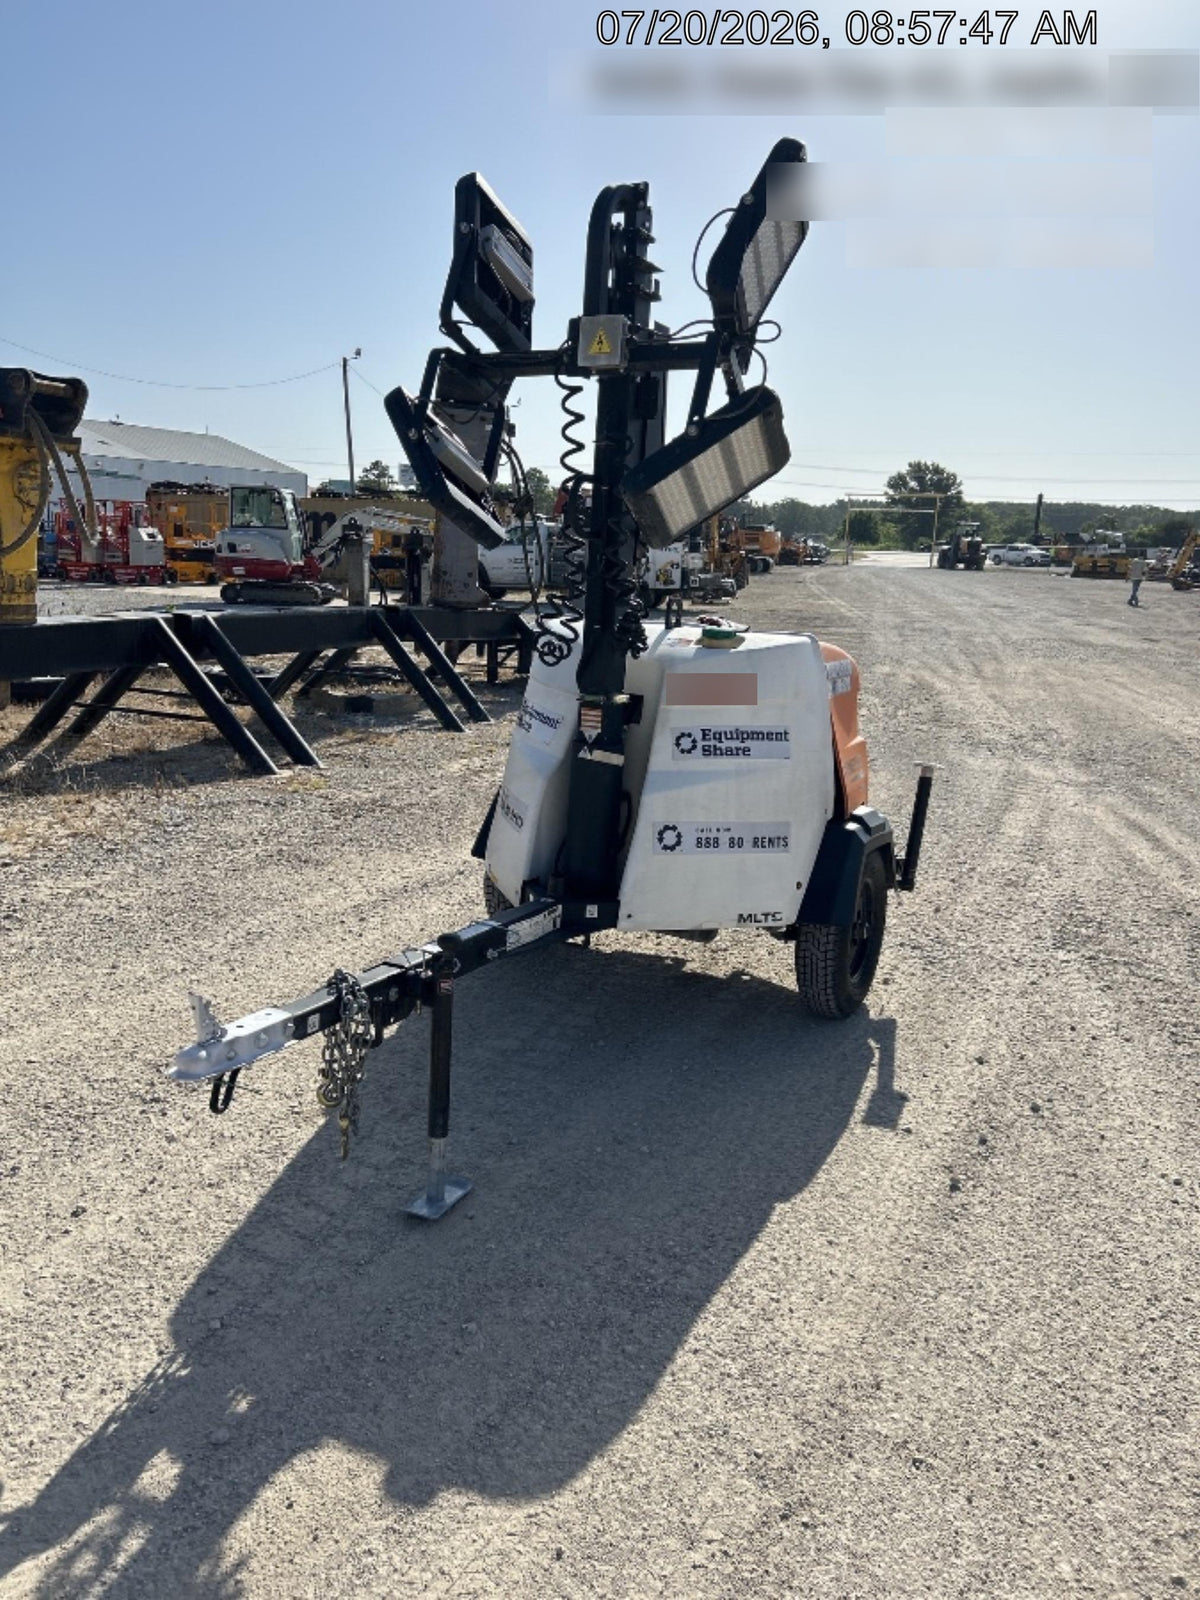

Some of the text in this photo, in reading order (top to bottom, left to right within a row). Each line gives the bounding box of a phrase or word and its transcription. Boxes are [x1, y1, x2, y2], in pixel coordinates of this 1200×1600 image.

[700, 728, 790, 743] Equipment
[701, 744, 751, 757] Share
[696, 836, 789, 849] 888 80 RENTS
